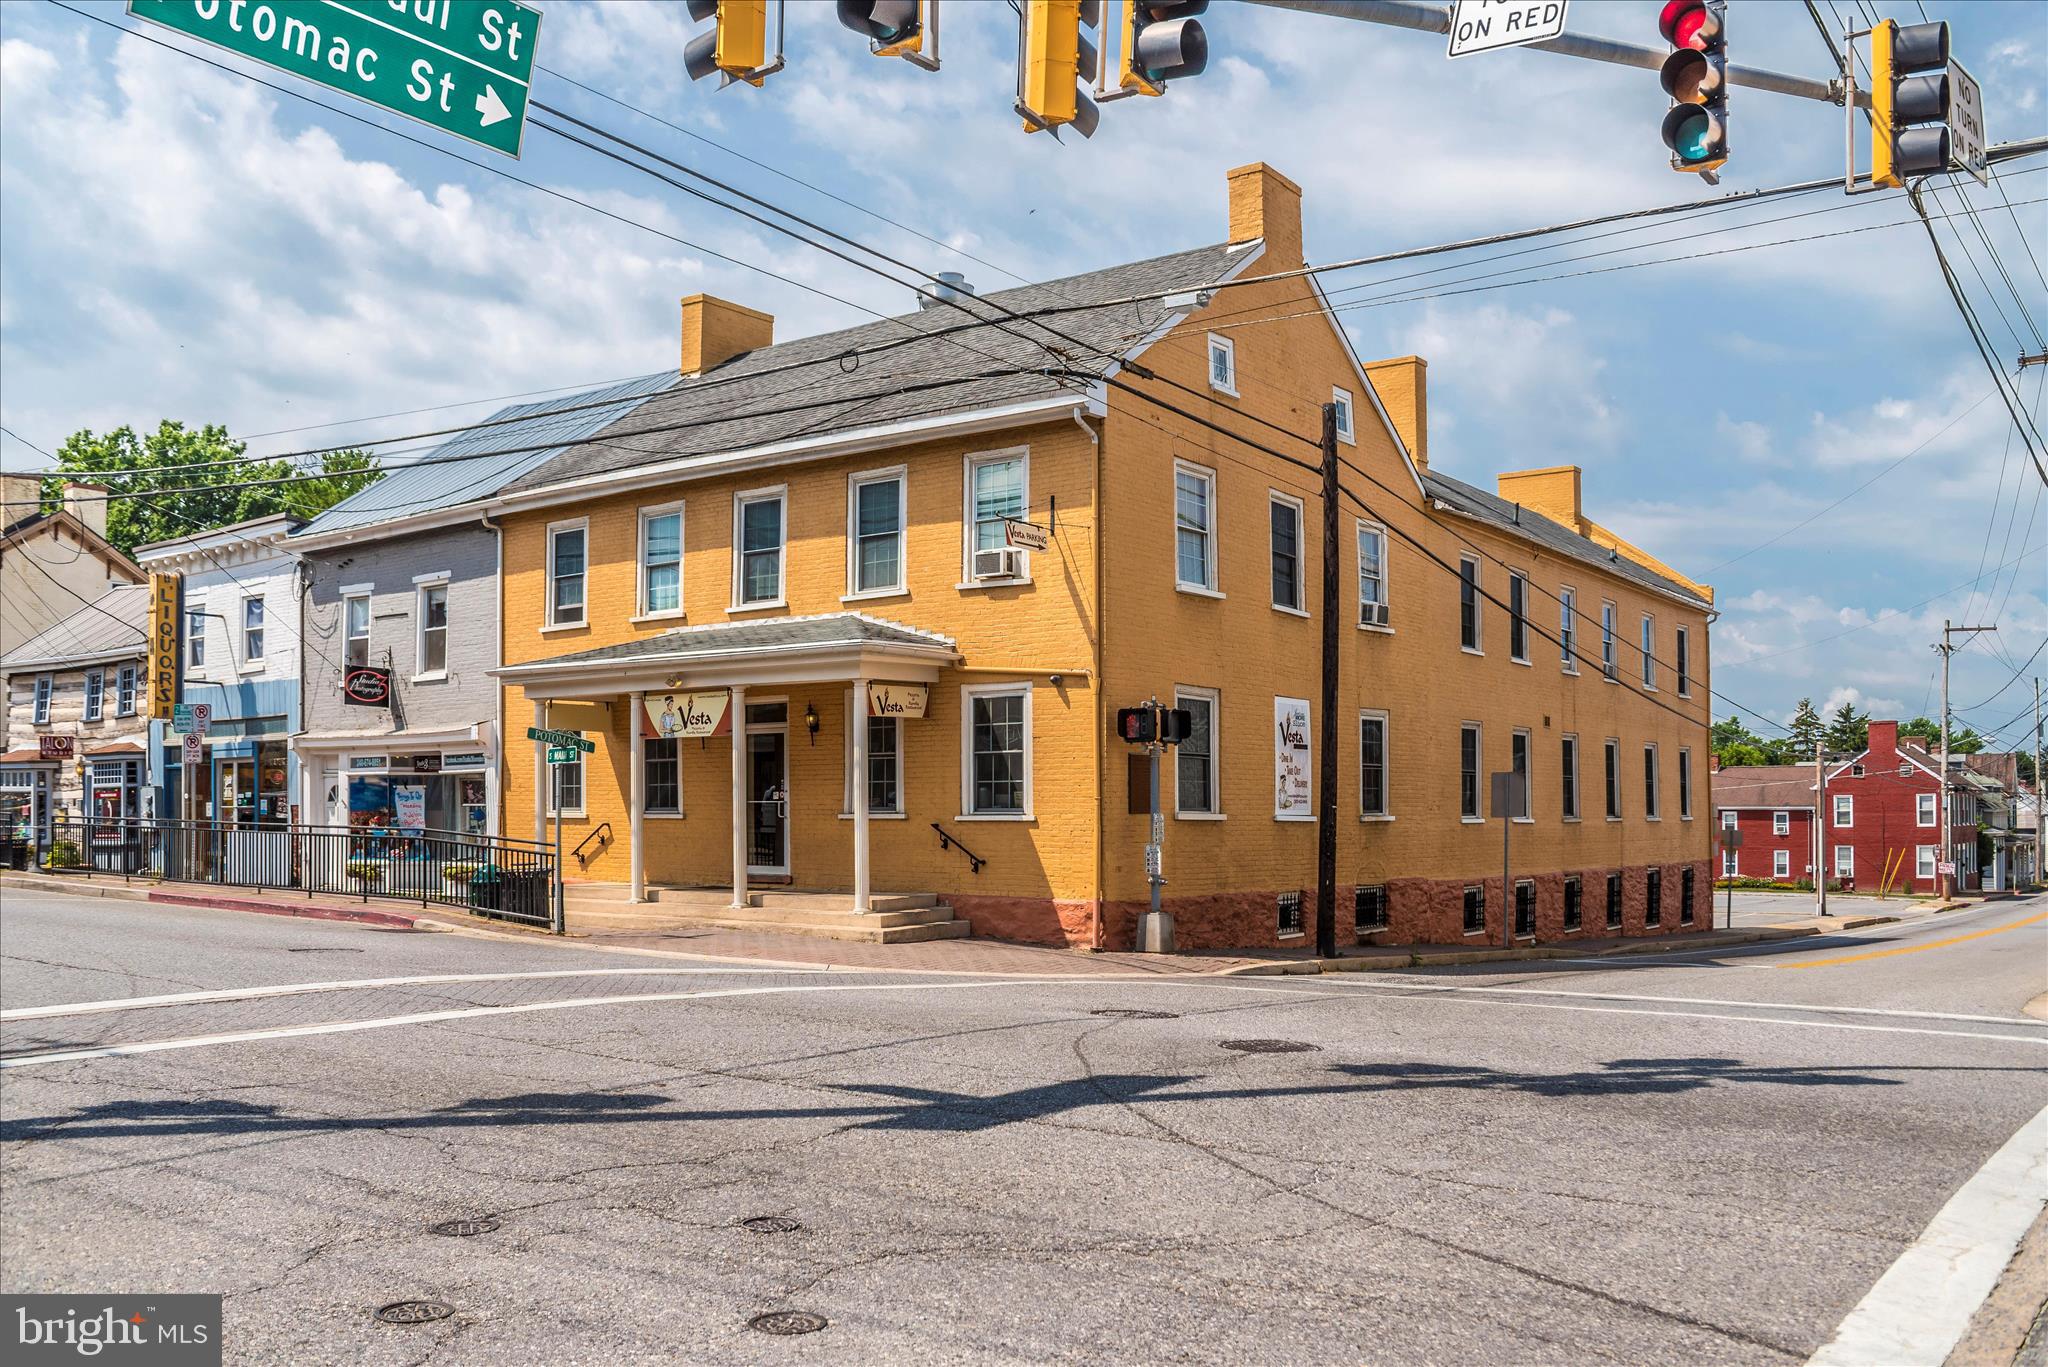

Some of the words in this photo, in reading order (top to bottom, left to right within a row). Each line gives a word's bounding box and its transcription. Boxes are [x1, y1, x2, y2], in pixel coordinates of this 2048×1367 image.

[478, 8, 522, 61] St
[1458, 16, 1492, 42] ON
[1505, 3, 1559, 32] RED
[157, 0, 379, 83] otomac
[406, 58, 456, 113] St
[1957, 77, 1972, 105] NO
[1955, 102, 1979, 140] TURN
[1953, 129, 1965, 155] ON
[1967, 142, 1986, 171] RED
[1007, 522, 1026, 540] Vesta
[1025, 532, 1048, 545] PARKING
[159, 587, 174, 703] LIQUORS
[677, 704, 712, 730] Vesta
[876, 693, 904, 715] Vesta
[41, 736, 74, 750] TALON
[535, 730, 578, 748] POTOMAC
[580, 742, 590, 751] ST
[1279, 721, 1304, 747] Vesta
[549, 752, 553, 760] S
[569, 750, 574, 759] ST
